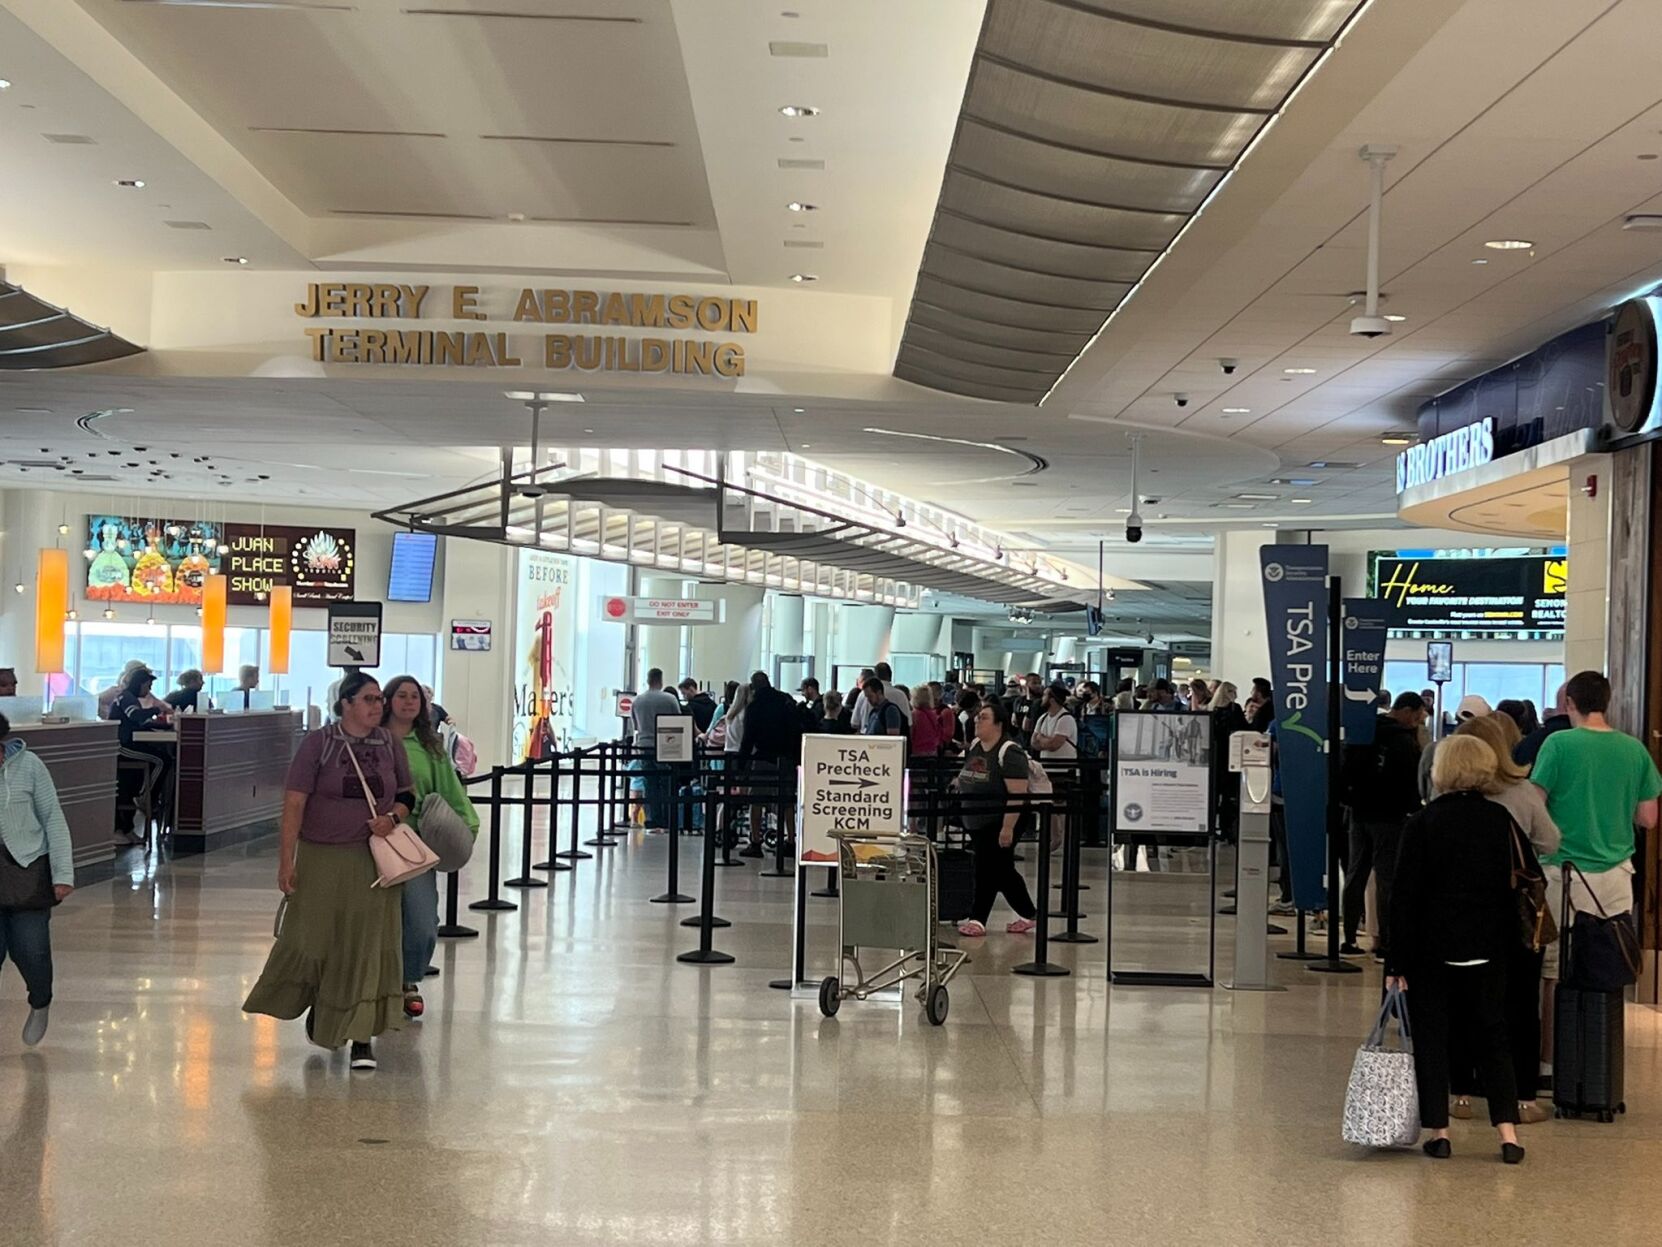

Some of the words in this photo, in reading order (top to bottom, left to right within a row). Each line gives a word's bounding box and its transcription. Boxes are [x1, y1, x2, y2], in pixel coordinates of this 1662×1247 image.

[295, 283, 429, 318] JERRY
[453, 285, 487, 320] E.
[513, 288, 758, 333] ABRAMSON
[304, 328, 521, 366] TERMINAL
[545, 334, 745, 377] BUILDING
[1406, 416, 1493, 489] BROTHERS
[231, 536, 274, 552] JUAN
[231, 557, 283, 572] PLACE
[528, 565, 568, 584] BEFORE
[231, 577, 274, 592] SHOW
[1380, 562, 1455, 608] Home.
[333, 622, 376, 632] SECURITY
[1286, 602, 1313, 656] TSA
[1347, 650, 1380, 661] Enter
[1348, 663, 1378, 673] Here
[1286, 664, 1313, 709] Pre
[514, 684, 574, 716] Maer's
[838, 749, 870, 762] TSA
[817, 762, 891, 776] Precheck
[1124, 768, 1140, 776] TSA
[1142, 768, 1149, 776] is
[1151, 769, 1177, 779] Hiring
[816, 789, 889, 804] Standard
[812, 803, 892, 820] Screening
[834, 817, 869, 829] KCM
